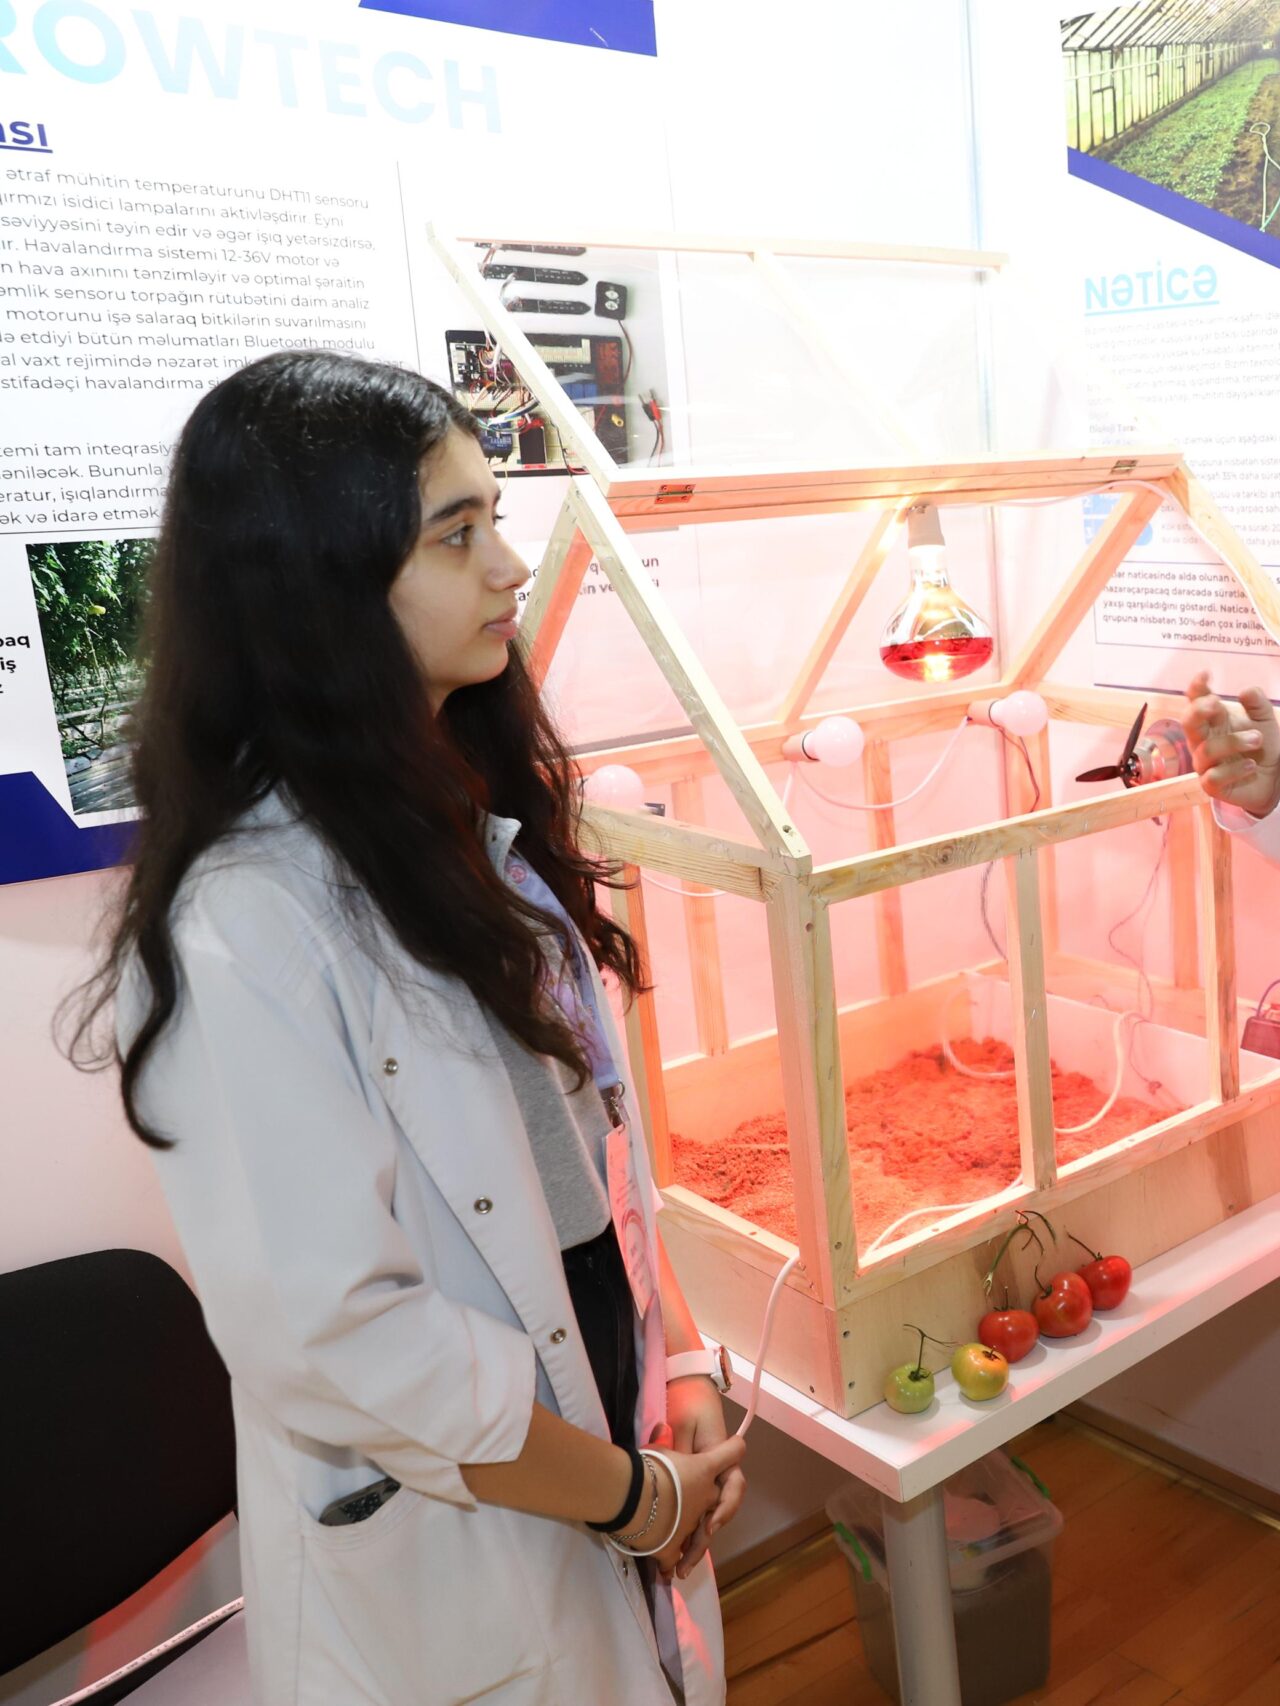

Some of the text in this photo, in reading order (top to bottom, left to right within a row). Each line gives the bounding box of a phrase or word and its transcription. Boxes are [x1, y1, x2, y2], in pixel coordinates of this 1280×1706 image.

[6, 169, 369, 209] ətraf mühitin temperaturunu DHT11 sensoru
[63, 193, 114, 210] isidici
[120, 198, 215, 217] lampalarını
[315, 213, 344, 228] Eyni
[1, 214, 101, 232] səviyyəsini
[107, 222, 150, 237] təyin
[156, 224, 188, 237] edir
[192, 228, 212, 239] və
[216, 229, 252, 243] əgər
[257, 230, 282, 245] işıq
[24, 238, 153, 258] Havalandırma
[158, 246, 218, 261] sistemi
[222, 249, 271, 264] 12-36V
[276, 252, 320, 266] motor
[324, 257, 340, 268] və
[18, 260, 365, 290] hava axınını tənzimləyir və optimal şəraitin
[1084, 260, 1218, 309] NƏTİCƏ
[54, 288, 126, 301] sensoru
[131, 290, 204, 306] torpağın
[209, 293, 286, 307] rütubətini
[291, 295, 328, 308] daim
[332, 298, 370, 310] analiz
[6, 309, 366, 329] motorunu işə salaraq bitkilərin suvarılmasını
[20, 331, 375, 349] etdiyi bütün məlumatları Bluetooth modulu
[21, 354, 61, 367] vaxt
[67, 354, 152, 370] rejimində
[157, 356, 219, 368] nəzarət
[85, 376, 204, 389] havalandırma
[44, 443, 81, 456] tam
[0, 463, 163, 480] əniləcək. Bununla
[26, 512, 48, 523] və
[53, 509, 98, 523] idarə
[103, 506, 160, 521] etmək
